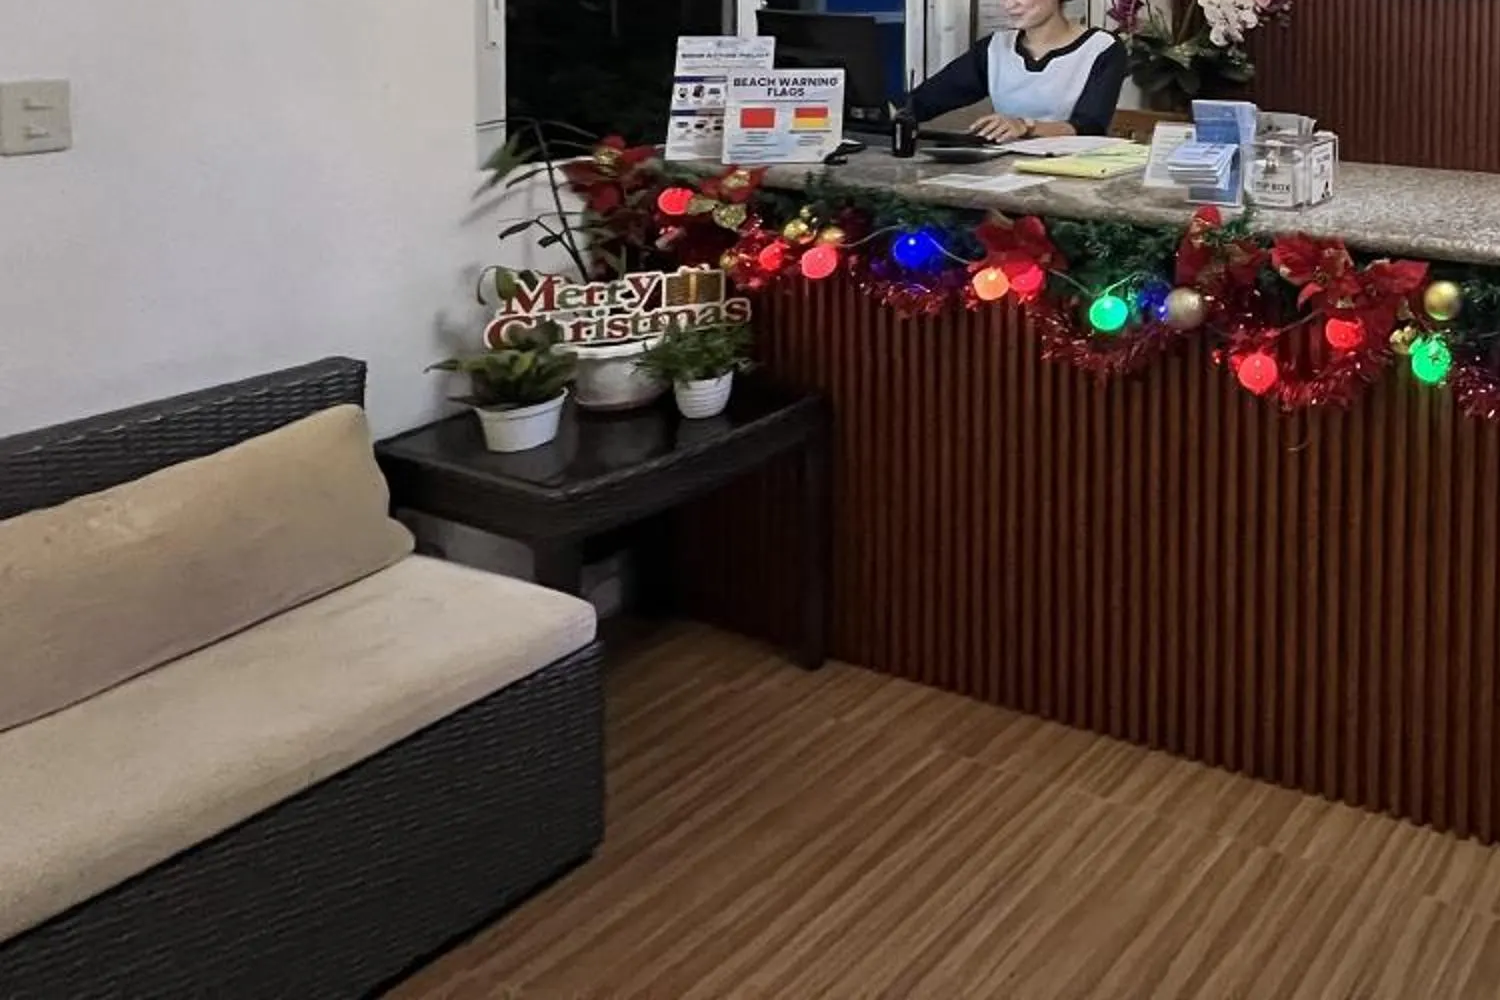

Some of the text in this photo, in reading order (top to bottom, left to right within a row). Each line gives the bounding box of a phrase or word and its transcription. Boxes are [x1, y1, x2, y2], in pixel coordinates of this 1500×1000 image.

[733, 77, 839, 87] BEACH WARNING
[767, 87, 806, 97] FLAGS
[500, 271, 662, 316] Merry
[485, 298, 751, 349] Cristmas
